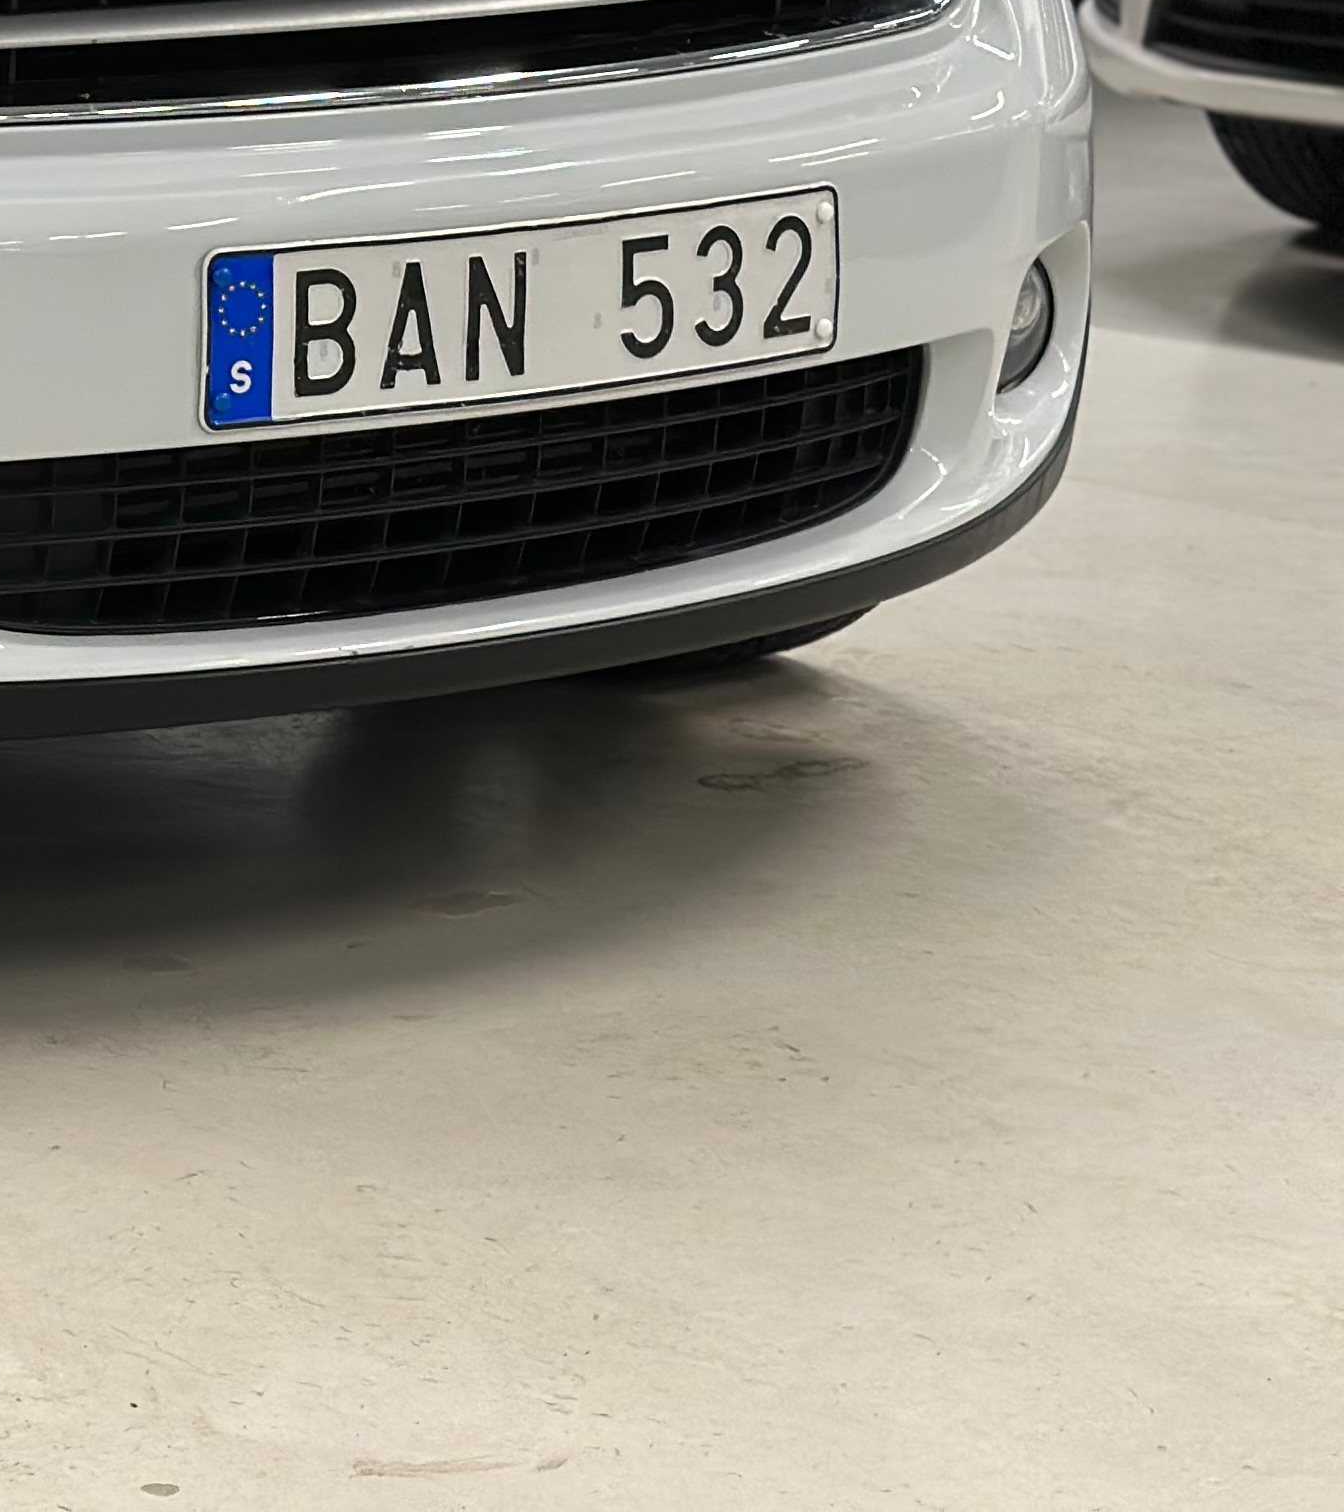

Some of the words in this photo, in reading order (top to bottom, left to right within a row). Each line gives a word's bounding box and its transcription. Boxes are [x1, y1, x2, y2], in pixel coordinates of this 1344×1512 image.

[293, 250, 527, 398] BAN
[619, 214, 812, 359] 532
[229, 359, 253, 394] S
